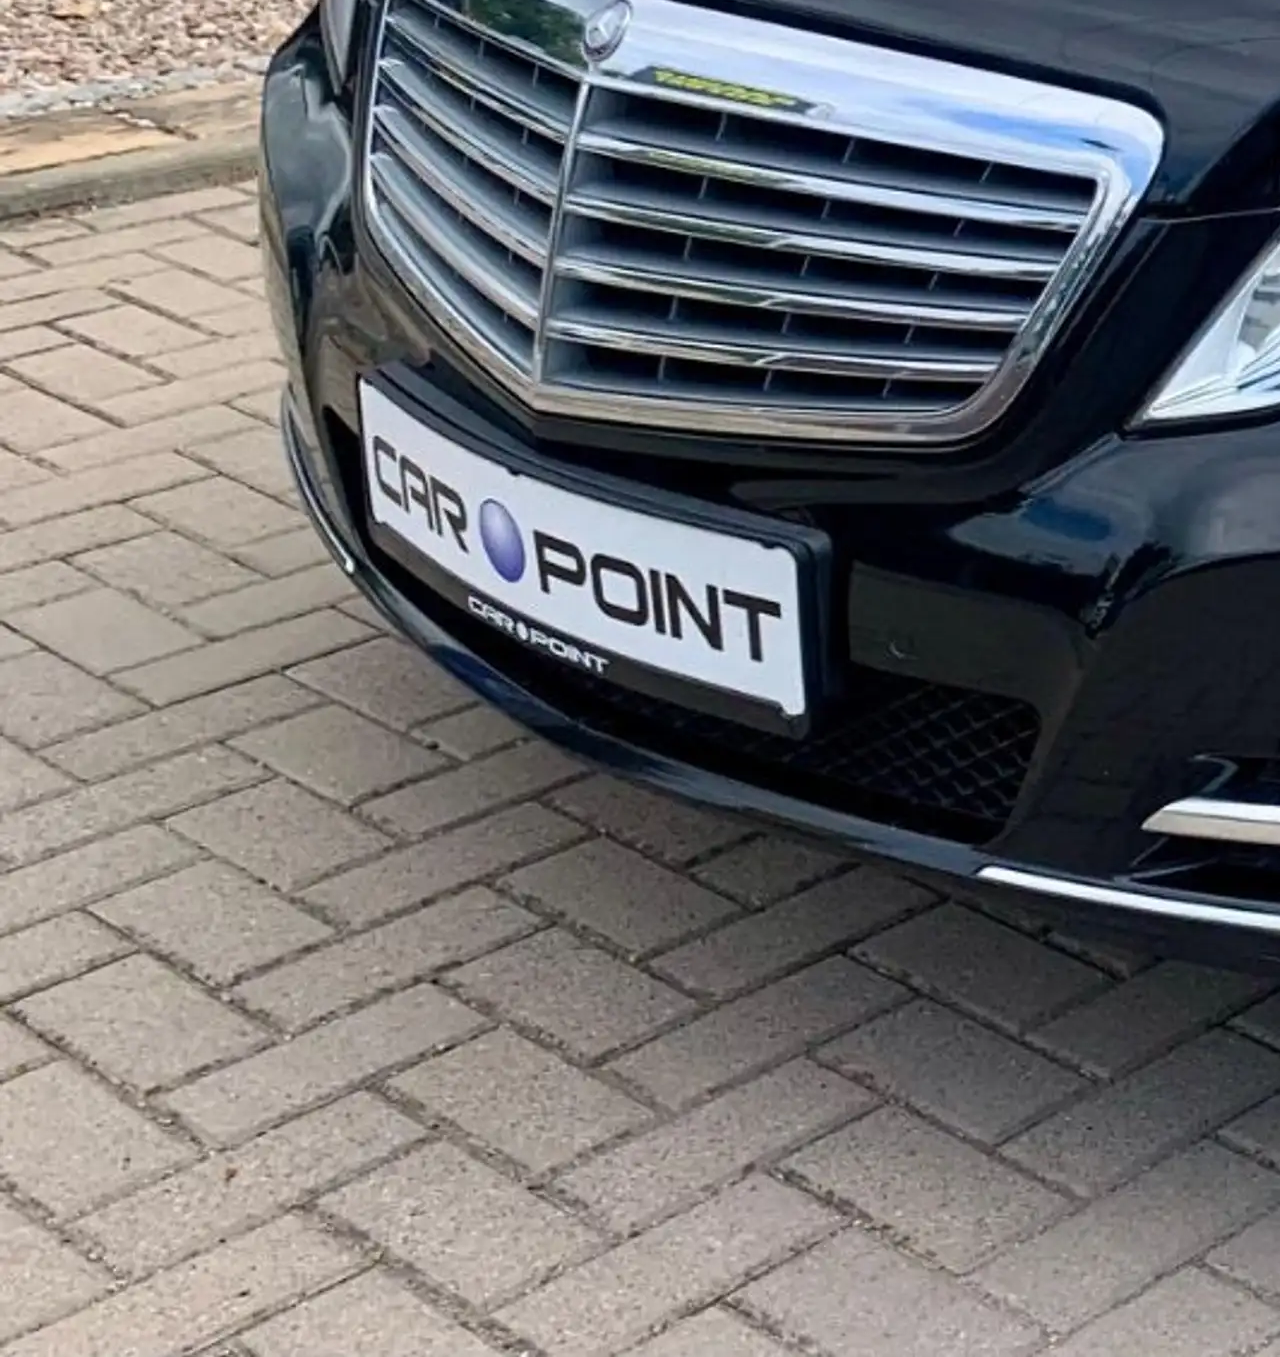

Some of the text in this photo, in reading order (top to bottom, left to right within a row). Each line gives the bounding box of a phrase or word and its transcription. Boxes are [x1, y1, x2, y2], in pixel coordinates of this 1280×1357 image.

[372, 434, 782, 663] CAR POINT
[467, 594, 610, 675] CAR POINT
